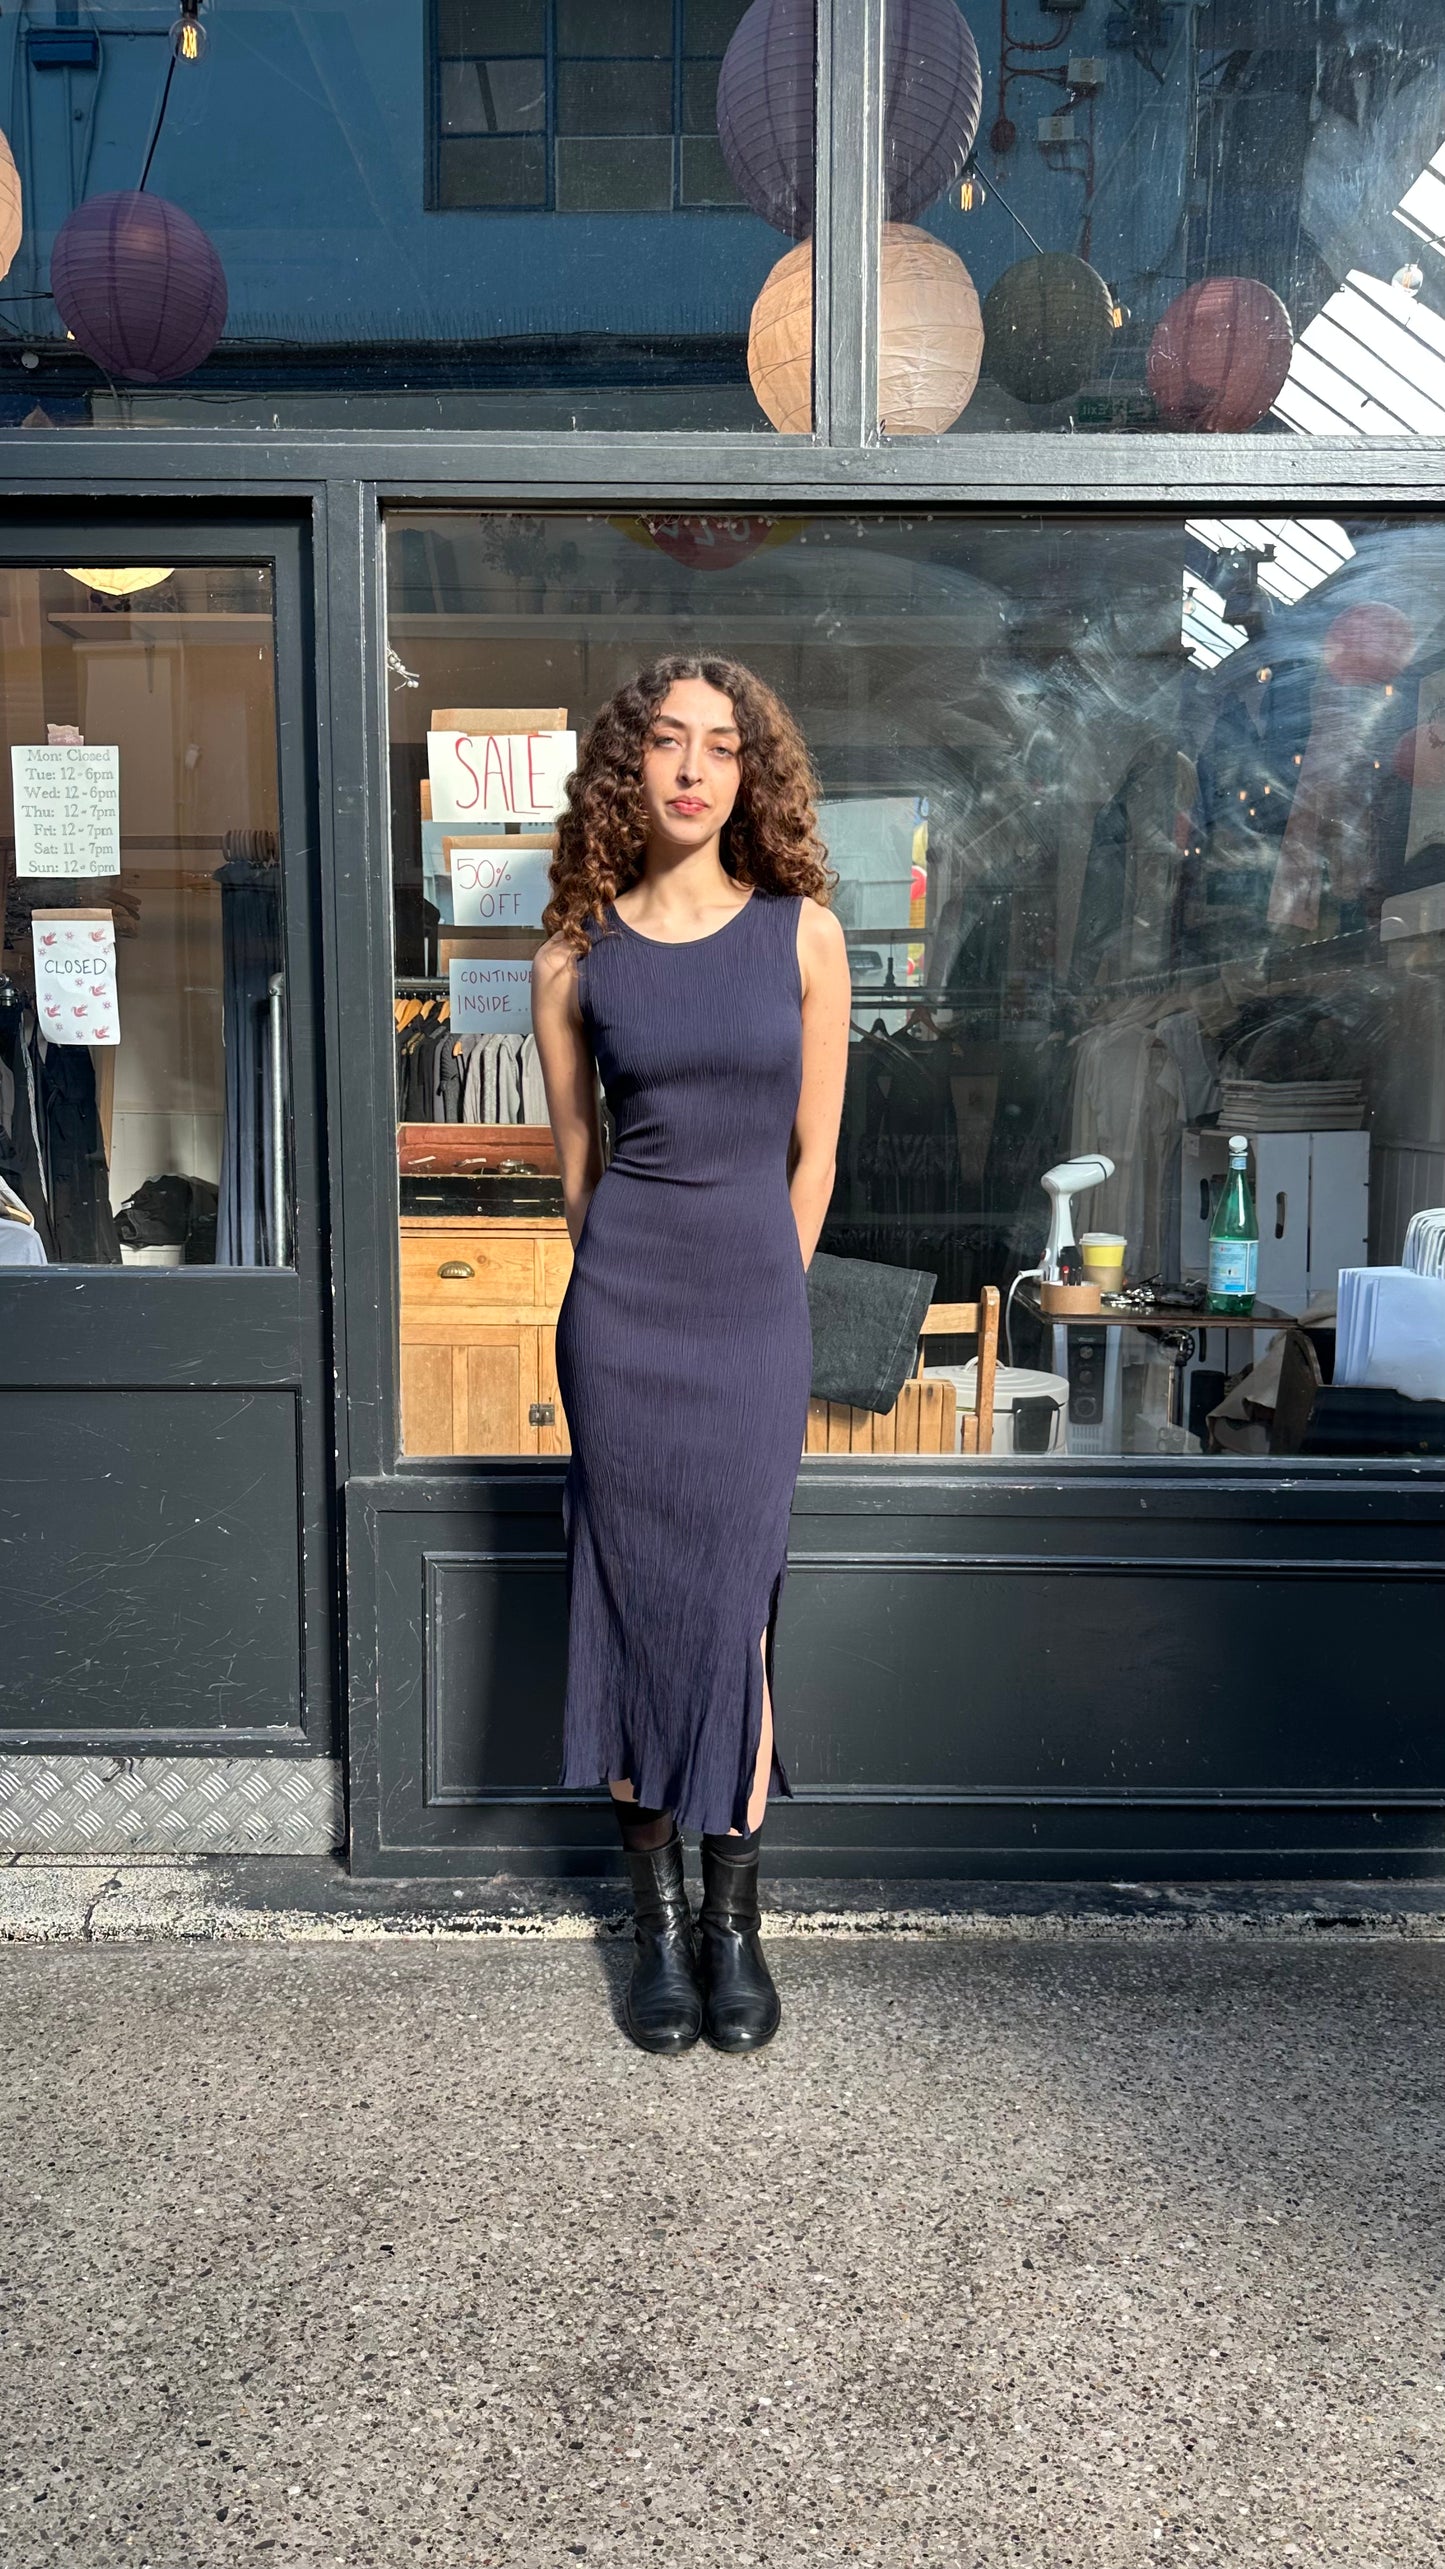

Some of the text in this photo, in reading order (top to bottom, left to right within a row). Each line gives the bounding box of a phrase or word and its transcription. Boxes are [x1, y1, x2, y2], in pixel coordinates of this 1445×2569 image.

[27, 749, 110, 762] Mon: Closed
[25, 767, 56, 780] Tue:
[455, 735, 554, 815] SALE
[24, 786, 60, 799] Wed:
[21, 805, 55, 818] Thu:
[33, 824, 56, 836] Fri:
[34, 842, 58, 855] Sat:
[29, 860, 59, 873] Sun:
[457, 857, 511, 889] 50%
[479, 893, 522, 917] OFF
[44, 958, 107, 975] CLOSED
